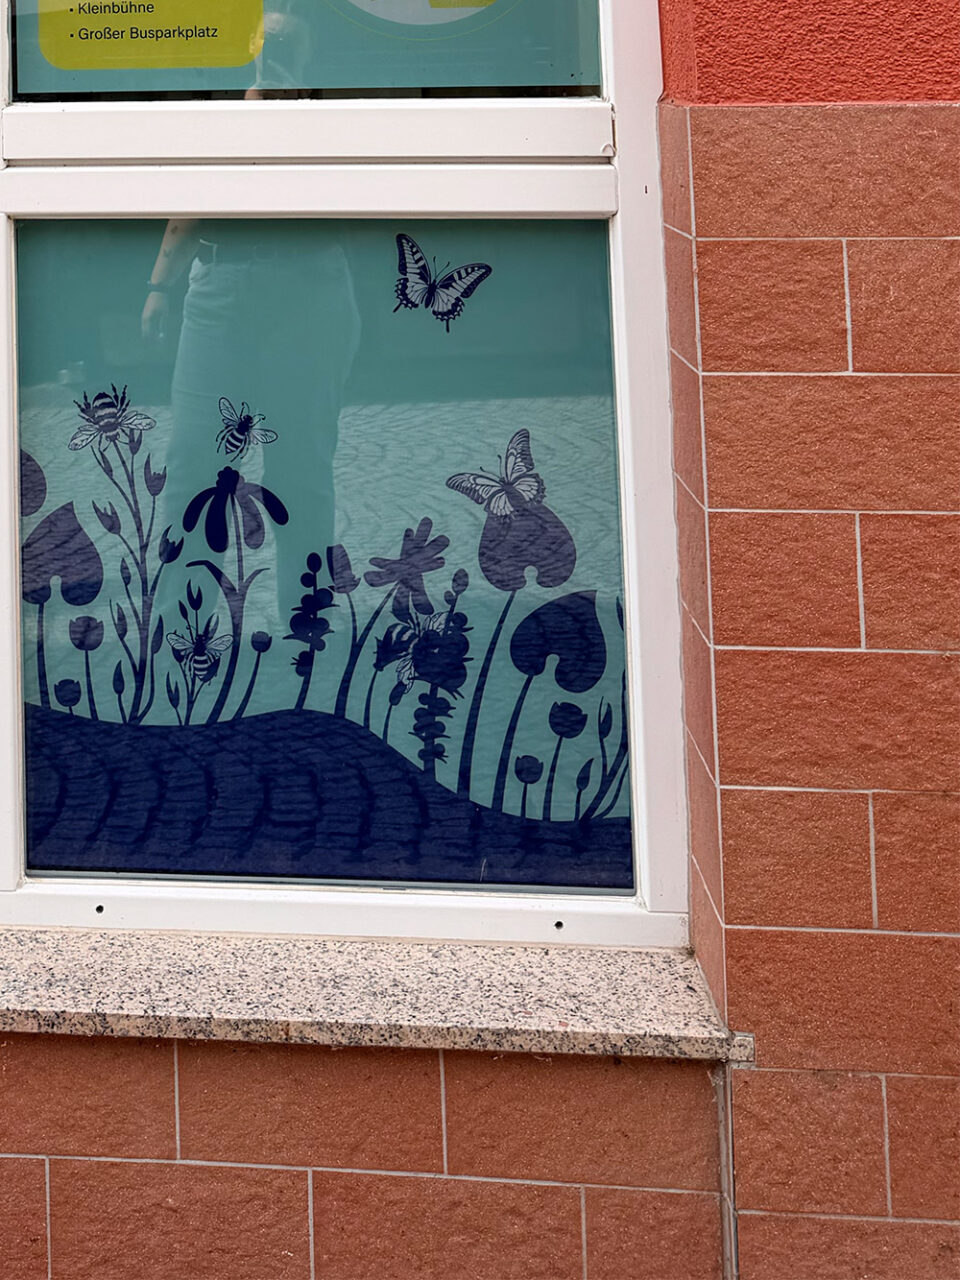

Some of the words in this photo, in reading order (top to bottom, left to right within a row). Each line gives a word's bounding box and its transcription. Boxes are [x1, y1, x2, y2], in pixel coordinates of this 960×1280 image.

[78, 1, 154, 15] Kleinbühne
[78, 27, 125, 40] Großer
[130, 25, 218, 41] Busparkplatz
